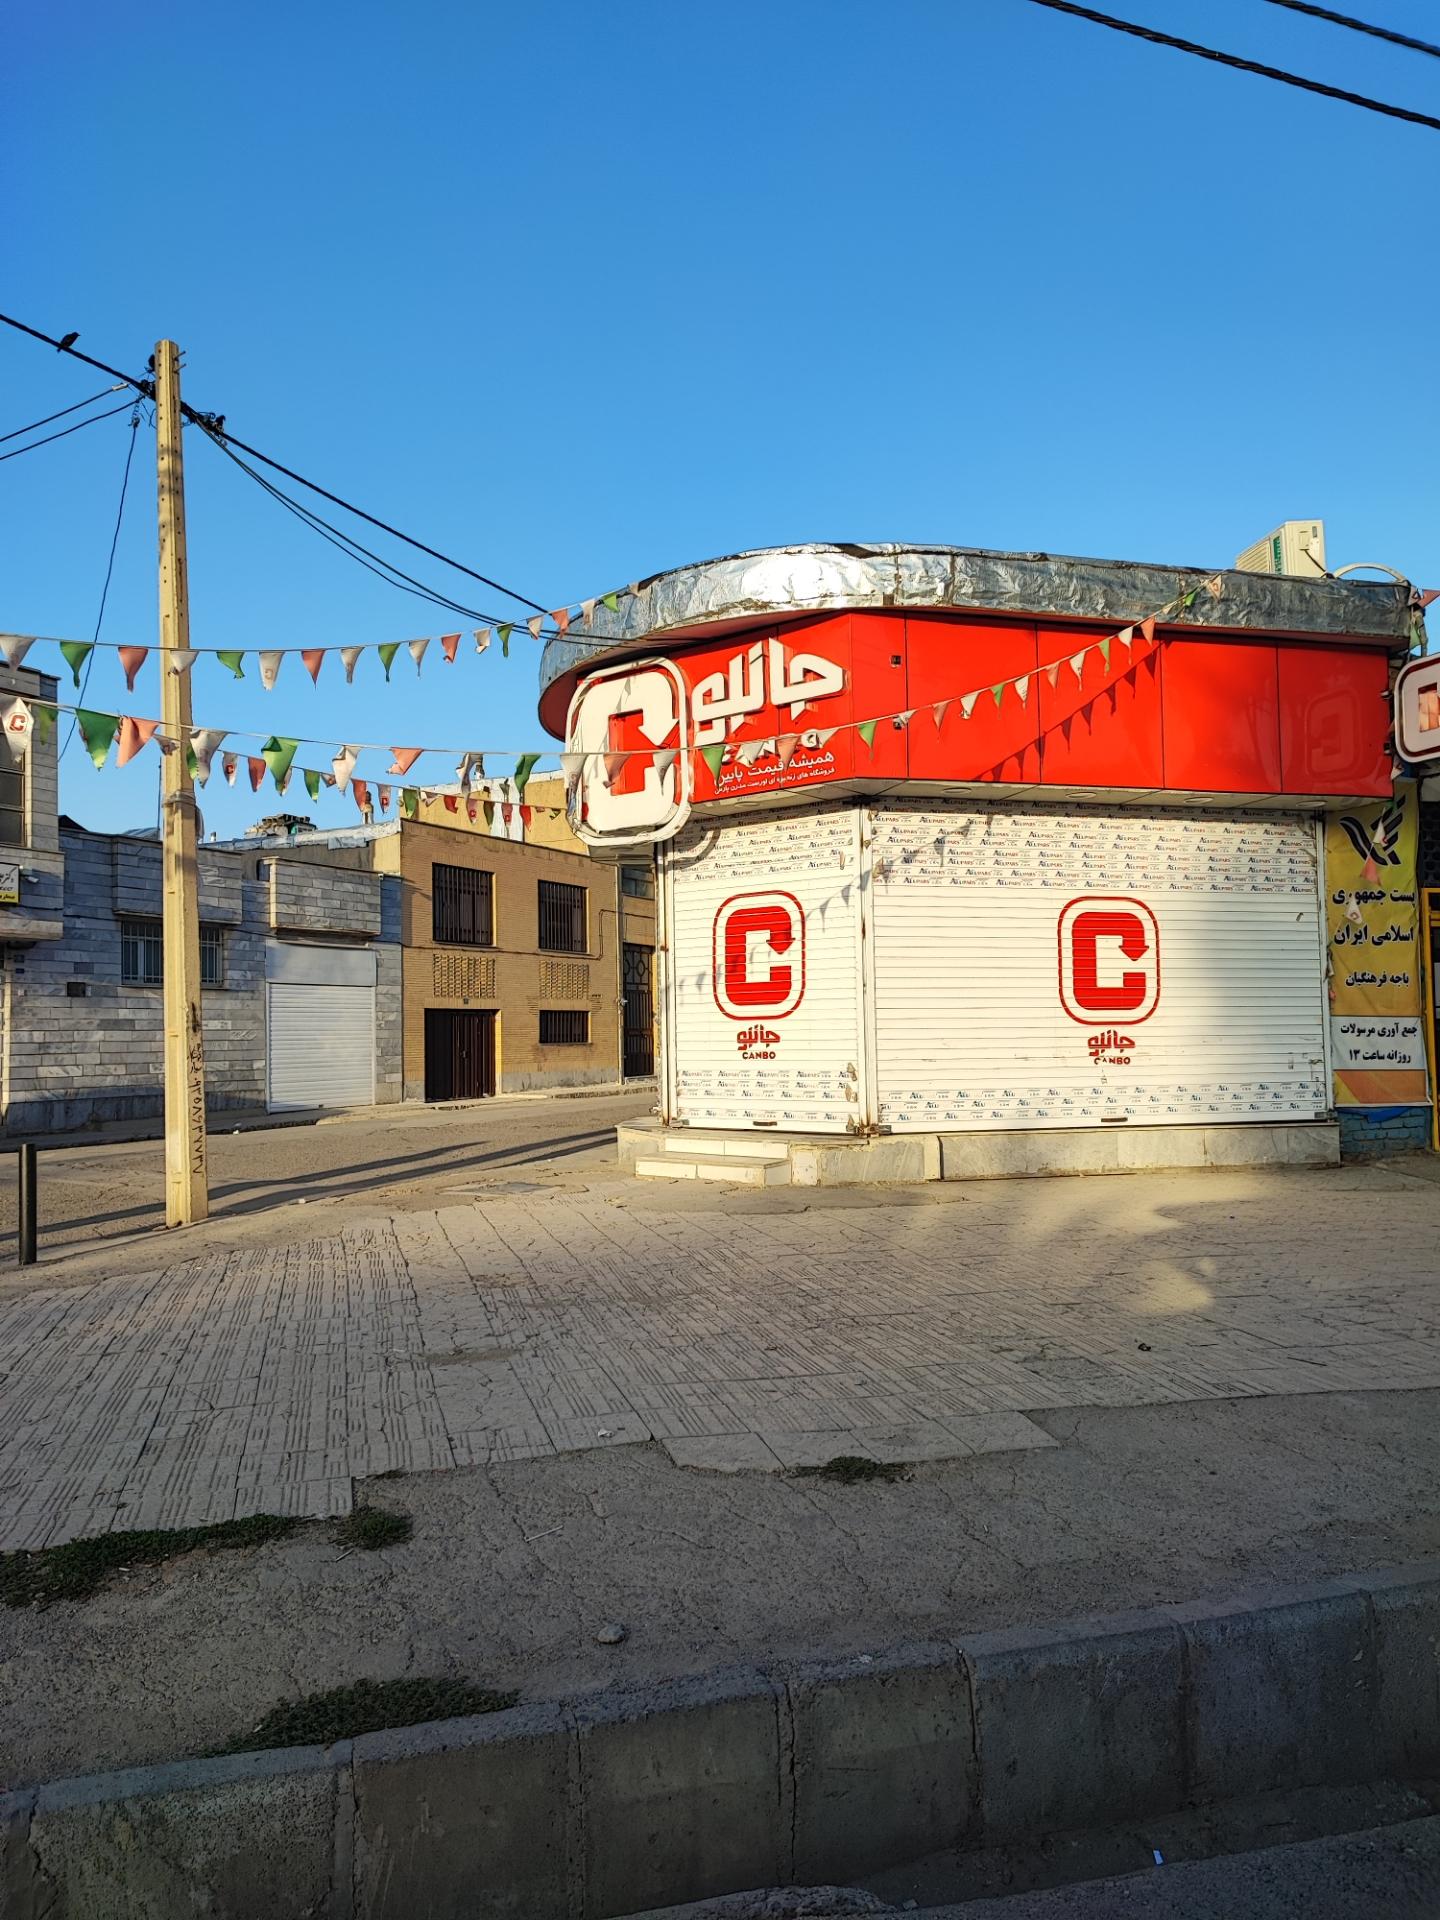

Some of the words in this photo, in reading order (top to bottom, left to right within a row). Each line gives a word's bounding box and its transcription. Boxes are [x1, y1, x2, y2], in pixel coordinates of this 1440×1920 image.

[691, 637, 844, 747] جانبو
[748, 759, 784, 776] قیمت
[788, 752, 834, 768] همیشه
[809, 766, 835, 776] فروشگاه
[1390, 890, 1415, 908] پست
[1334, 924, 1368, 945] ایران
[1371, 924, 1414, 946] اسلامی
[1346, 971, 1387, 988] فرهنگیان
[1390, 972, 1409, 987] باجه
[1341, 1023, 1376, 1037] مرسولات
[1377, 1022, 1399, 1037] آوری
[1402, 1026, 1418, 1037] جمع
[737, 1024, 781, 1051] جانبو
[1088, 1030, 1135, 1056] جانبو
[742, 1051, 776, 1060] CANBO
[1094, 1056, 1131, 1065] CANBO
[1349, 1049, 1360, 1061] ۱۳
[1363, 1050, 1385, 1061] ساعت
[1387, 1049, 1411, 1063] روزانه
